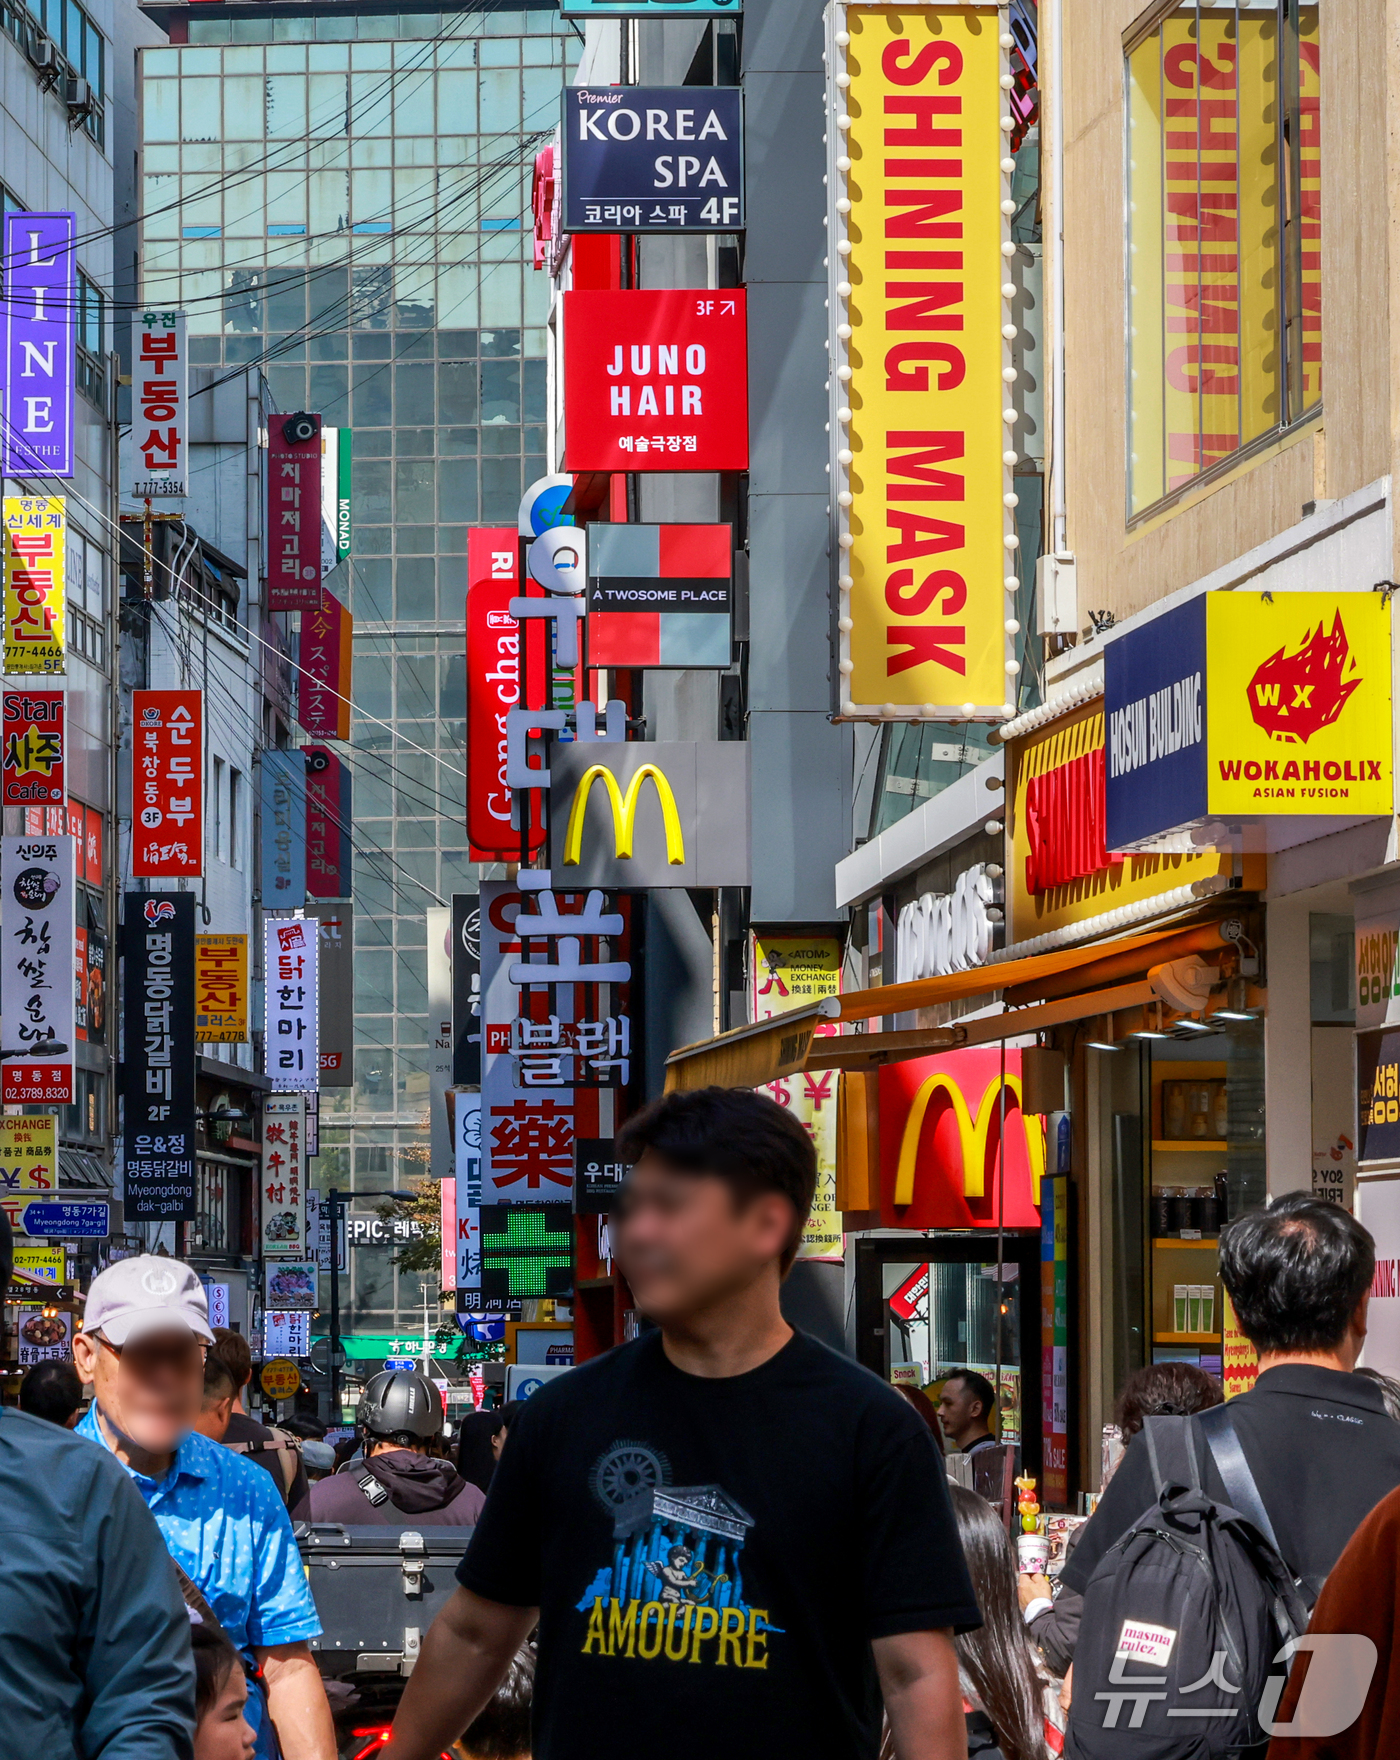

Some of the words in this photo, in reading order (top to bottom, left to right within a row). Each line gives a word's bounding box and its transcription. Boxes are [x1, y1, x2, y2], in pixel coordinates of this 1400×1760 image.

[577, 90, 623, 104] Premier
[579, 109, 728, 141] KOREA
[654, 156, 728, 188] SPA
[584, 205, 642, 225] 코리아
[649, 205, 687, 225] 스파
[700, 197, 738, 224] 4F
[881, 39, 966, 392] SHINING
[696, 301, 714, 315] 3F
[142, 312, 176, 329] 우진
[19, 231, 58, 433] LINE
[607, 344, 706, 376] JUNO
[140, 333, 181, 469] 부동산
[610, 385, 702, 415] HAIR
[618, 436, 697, 452] 예술극장점
[134, 481, 183, 496] T.777-5354
[20, 500, 48, 511] 명동
[8, 514, 61, 528] 신세계
[281, 463, 300, 580] 치마저고리
[339, 499, 350, 549] MONAD
[885, 430, 967, 677] MASK
[11, 534, 56, 641] 부동산
[593, 591, 603, 600] A
[606, 591, 677, 601] TWOSOME
[681, 591, 727, 601] PLACE
[5, 646, 62, 657] 777-4466
[44, 660, 60, 669] 5F
[486, 633, 520, 703] cha
[3, 695, 62, 721] Star
[1149, 671, 1202, 763] BUILDING
[4, 733, 62, 770] 사주
[143, 732, 160, 804] 북창동
[166, 706, 195, 827] 순두부
[1219, 759, 1382, 781] WOKAHOLIX
[8, 782, 48, 799] Cafe
[1253, 787, 1296, 798] ASIAN
[1300, 787, 1349, 798] FUSION
[144, 813, 159, 823] 3F
[16, 844, 57, 861] 신의주
[790, 964, 823, 972] MONEY
[198, 948, 241, 1012] 부동산
[143, 932, 174, 1100] 명동닭갈비
[277, 955, 306, 1070] 닭한마리
[12, 1070, 62, 1082] 명동점
[5, 1088, 69, 1100] 02.3789.8320
[148, 1106, 170, 1121] 2F
[134, 1134, 185, 1155] 은&정
[490, 1099, 575, 1188] 藥
[127, 1160, 192, 1178] 명동닭갈비
[128, 1184, 192, 1198] Myeongdong
[62, 1206, 106, 1217] 명동7가길
[137, 1199, 184, 1213] dak-galbi
[34, 1219, 80, 1227] Myeongdong
[81, 1219, 105, 1227] 7ga-gil
[263, 1374, 298, 1386] 부동산
[581, 1596, 769, 1669] AMOUPRE
[1124, 1626, 1170, 1646] masma
[1120, 1641, 1157, 1657] rulez.
